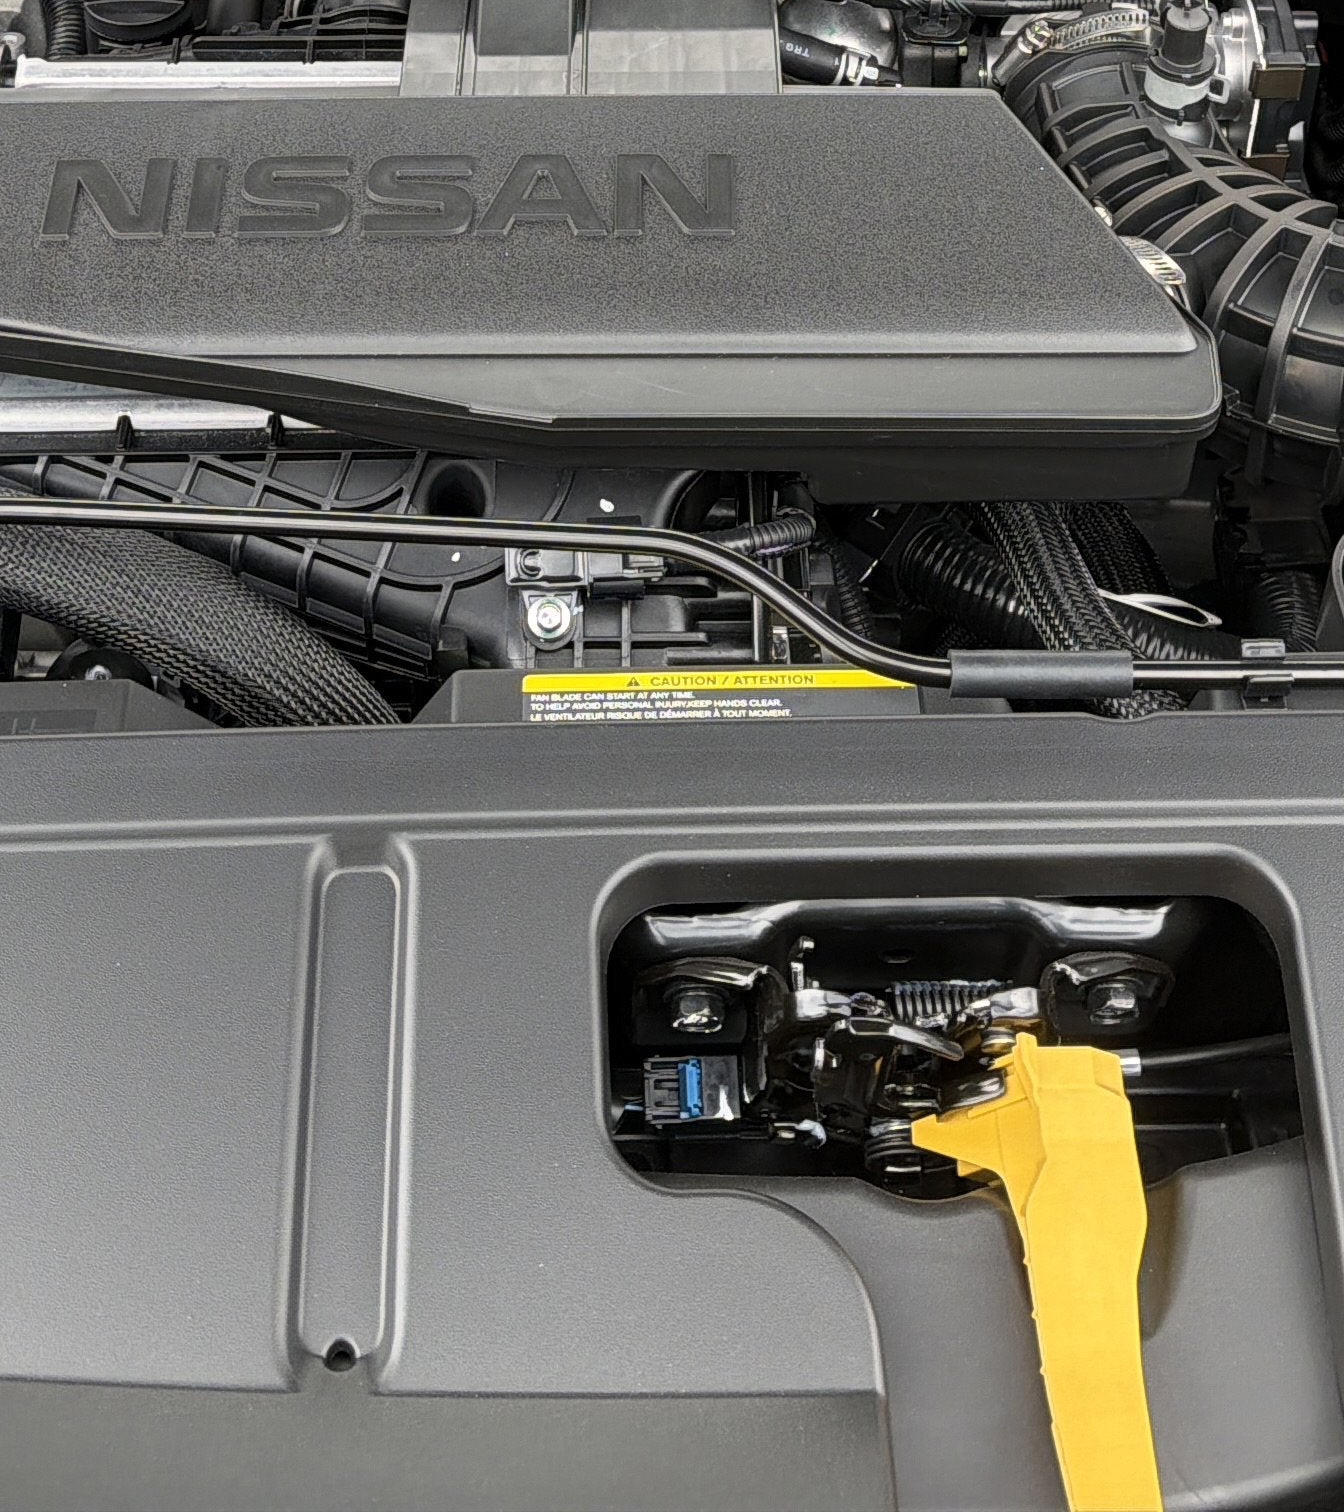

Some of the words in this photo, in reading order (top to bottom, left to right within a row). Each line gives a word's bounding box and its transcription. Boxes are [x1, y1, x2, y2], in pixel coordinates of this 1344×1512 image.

[39, 153, 736, 238] NISSAN
[650, 675, 717, 687] CAUTION
[733, 674, 815, 686] ATTENTION
[530, 693, 550, 702] FAN
[550, 693, 582, 702] BLADE
[583, 692, 605, 701] CAN
[606, 691, 636, 700] START
[637, 691, 649, 700] AT
[650, 691, 670, 699] ANY
[671, 690, 696, 699] TIME.
[530, 702, 545, 711] TO
[545, 702, 571, 711] HELP
[571, 701, 601, 710] AVOID
[602, 700, 654, 709] PERSONAL
[713, 699, 748, 708] HANDS
[748, 698, 783, 707] CLEAR.
[530, 713, 543, 722] LE
[543, 712, 605, 721] VENTILATEUR
[606, 711, 643, 720] RISQUE
[644, 710, 658, 719] DE
[659, 708, 712, 719] DÉMARRER
[712, 707, 721, 718] À
[721, 709, 747, 718] TOUT
